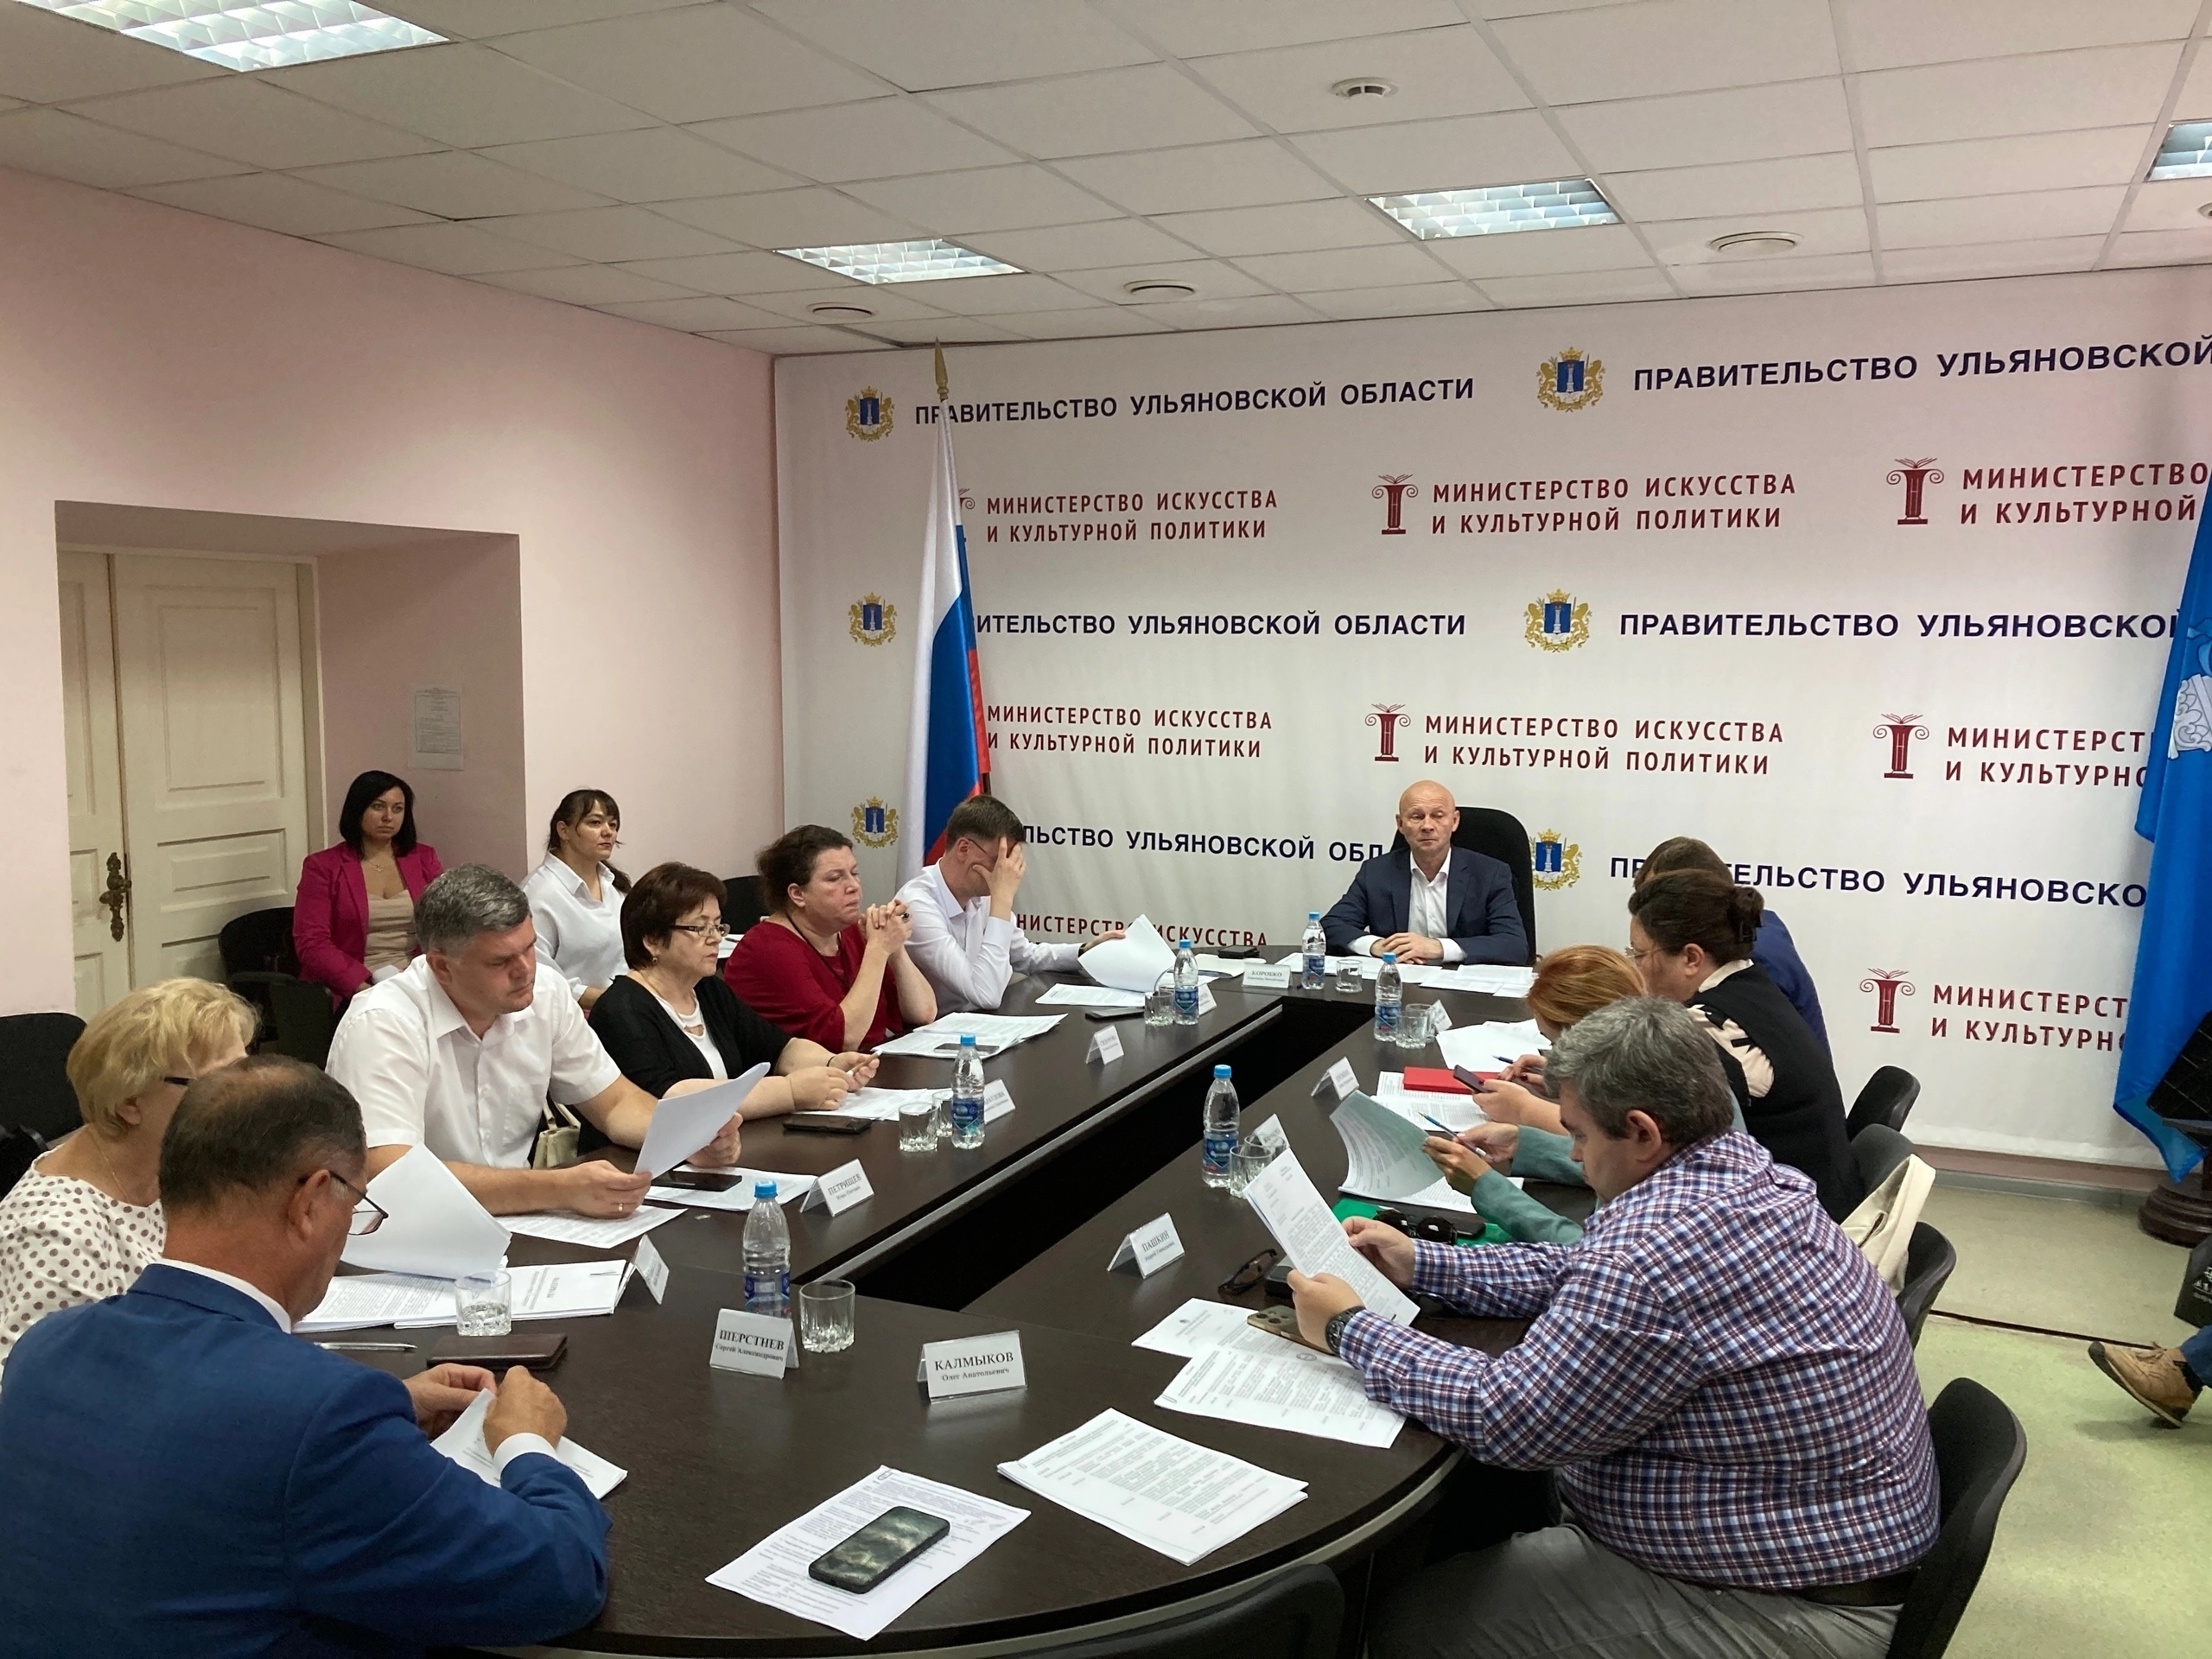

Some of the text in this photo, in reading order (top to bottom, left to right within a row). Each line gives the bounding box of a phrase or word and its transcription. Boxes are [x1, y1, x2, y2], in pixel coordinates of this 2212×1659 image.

[1635, 334, 2212, 391] ПРАВИТЕЛЬСТВО УЛЬЯНОВСКОЙ
[1130, 381, 1325, 415] УЛЬЯНОВСКОЙ
[1341, 378, 1472, 404] ОБЛАСТИ
[1433, 474, 1795, 503] МИНИСТЕРСТВО ИСКУССТВА
[1962, 462, 2208, 490] МИНИСТЕРСТВО
[988, 490, 1276, 514] МИНИСТЕРСТВО ИСКУССТВА
[1961, 494, 2195, 524] И КУЛЬТУРНОЙ
[988, 519, 1264, 542] И КУЛЬТУРНОЙ ПОЛИТИКИ
[1433, 507, 1779, 534] И КУЛЬТУРНОЙ ПОЛИТИКИ
[977, 610, 1465, 634] ИТЕЛЬСТВО УЛЬЯНОВСКОЙ ОБЛАСТИ
[1621, 614, 1897, 636] ПРАВИТЕЛЬСТВО
[988, 706, 1271, 728] МИНИСТЕРСТВО ИСКУССТВА
[1427, 715, 1783, 742] МИНИСТЕРСТВО ИСКУССТВА
[988, 733, 1259, 757] И КУЛЬТУРНОЙ ПОЛИТИКИ
[1948, 728, 2145, 753] МИНИСТЕРСТ
[1426, 746, 1767, 774] И КУЛЬТУРНОЙ ПОЛИТИКИ
[1946, 761, 1961, 780] И
[1127, 831, 1313, 859] УЛЬЯНОВСКОЙ
[1904, 872, 2147, 907] УЛЬЯНОВСКО
[1933, 984, 2127, 1019] МИНИСТЕРСТ
[1932, 1018, 2125, 1052] И КУЛЬТУРН
[720, 1330, 785, 1351] ШЕРСТНЕВ
[935, 1351, 1014, 1371] КАЛМЫКОВ
